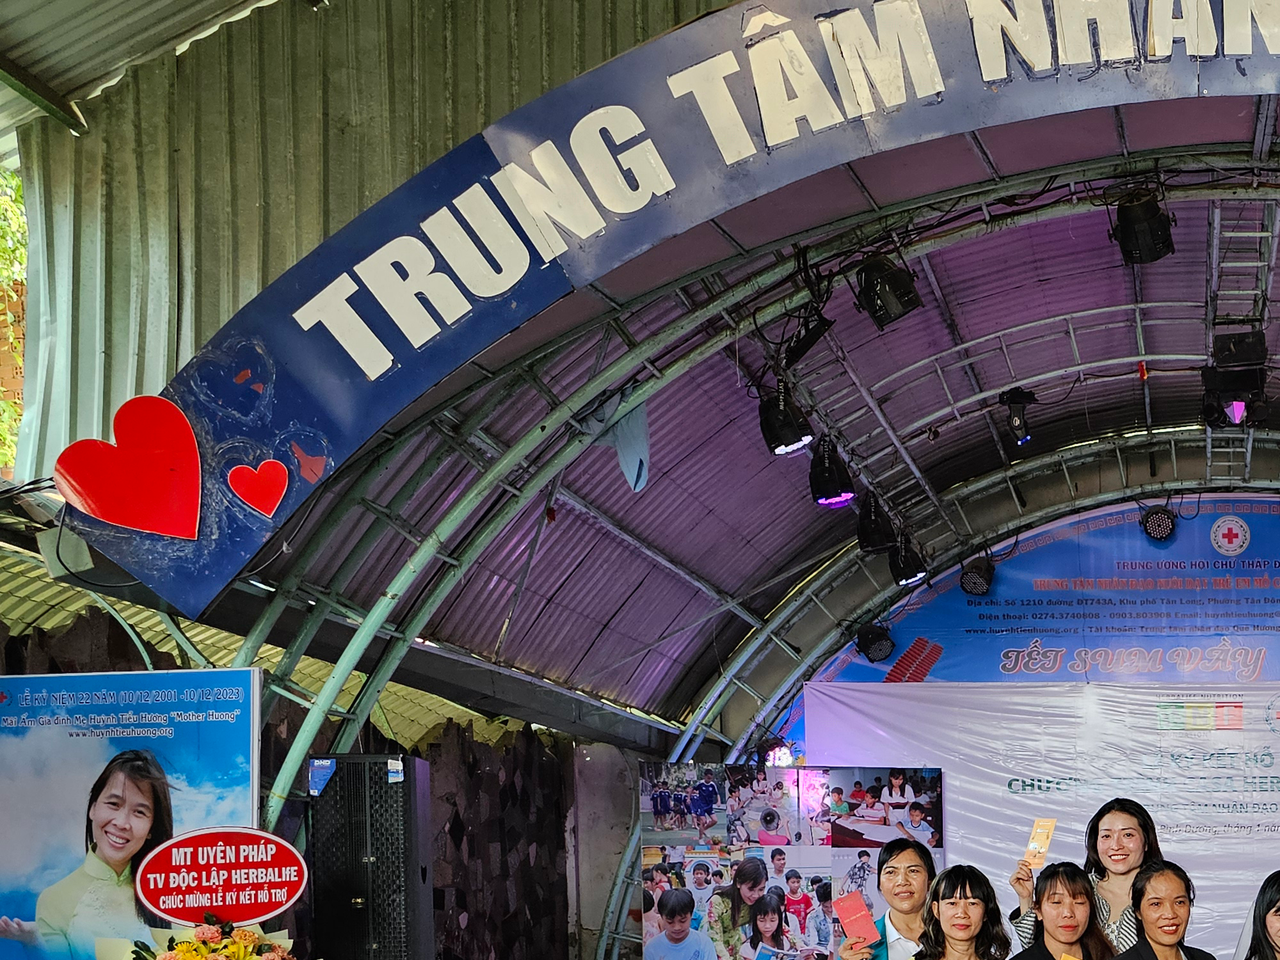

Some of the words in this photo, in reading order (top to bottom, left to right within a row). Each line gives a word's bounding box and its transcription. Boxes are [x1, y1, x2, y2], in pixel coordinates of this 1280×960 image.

[292, 104, 676, 382] TRUNG
[667, 1, 945, 165] TÂM
[1116, 561, 1153, 570] TRUNG
[1157, 558, 1187, 570] ƯƠNG
[1021, 598, 1044, 607] 1210
[1032, 611, 1100, 620] 0274.3740808
[1000, 637, 1066, 674] TẾT
[1067, 647, 1164, 674] SUM
[78, 692, 91, 705] 22
[68, 726, 174, 739] www.huynhtieuhuong.org
[171, 847, 194, 866] MT
[198, 841, 236, 865] UYÊN
[239, 839, 277, 863] PHÁP
[147, 873, 166, 889] TV
[169, 868, 198, 890] ĐỘC
[201, 866, 228, 889] LẬP
[159, 891, 184, 909] CHÚC
[185, 890, 211, 908] MỪNG
[212, 886, 223, 906] LỄ
[225, 888, 238, 905] KÝ
[239, 886, 256, 904] KẾT
[257, 883, 270, 903] HỖ
[271, 887, 288, 904] TRỢ
